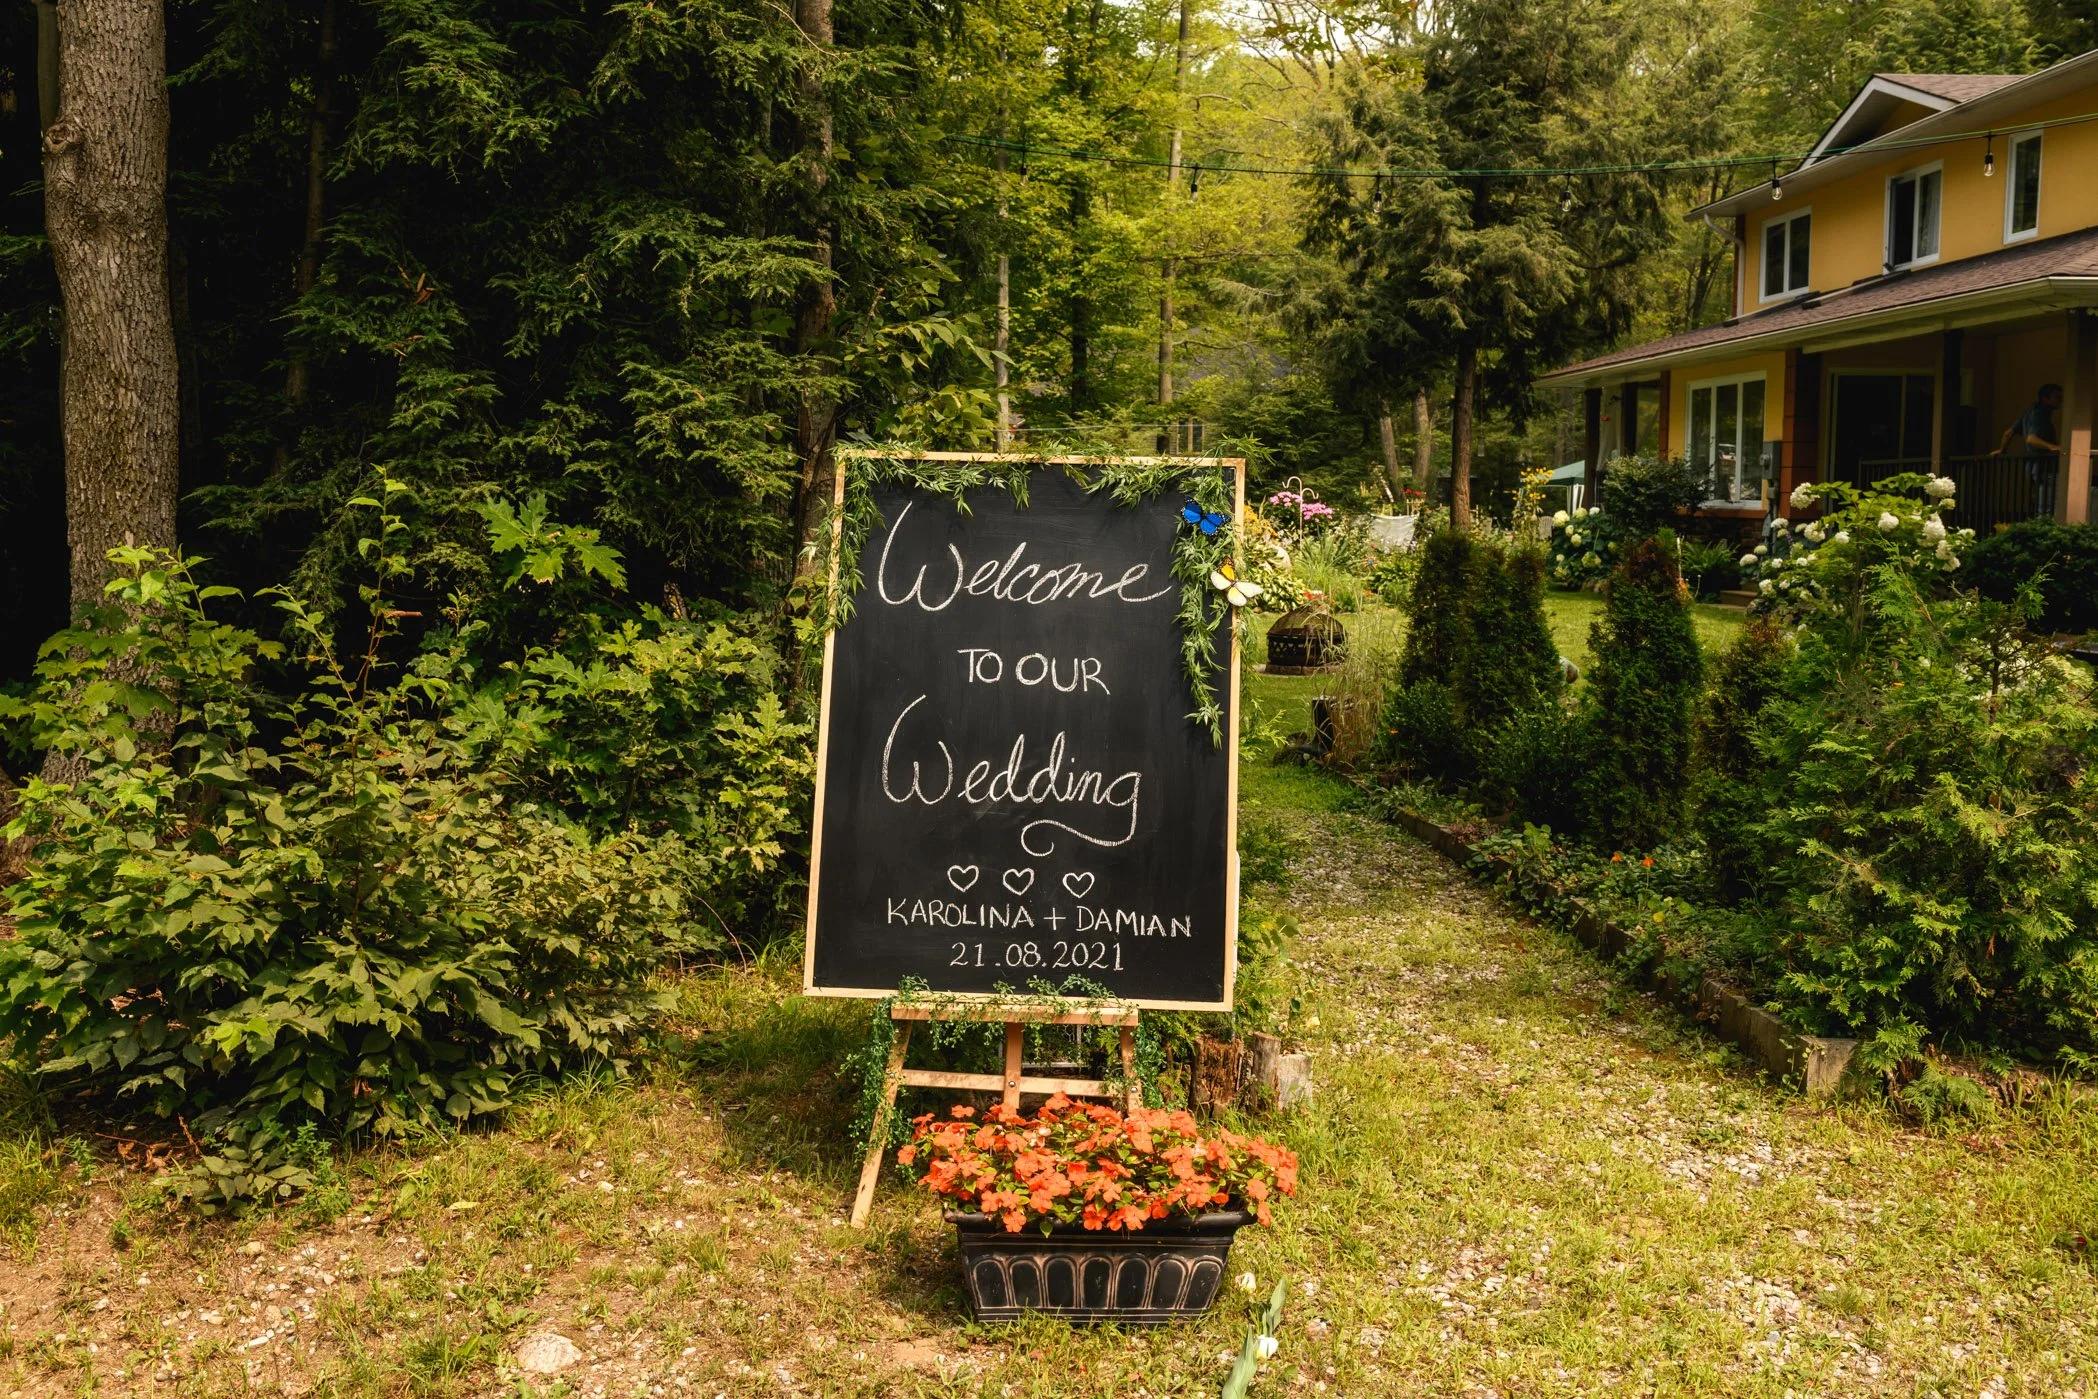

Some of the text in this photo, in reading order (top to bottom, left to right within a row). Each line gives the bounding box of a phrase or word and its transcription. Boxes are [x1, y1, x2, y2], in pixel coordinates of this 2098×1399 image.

[877, 500, 1172, 612] Welcome
[957, 648, 1111, 696] TO OUR
[881, 694, 1143, 857] Wedding
[887, 898, 1035, 930] KAROLINA
[1076, 905, 1193, 938] DAMIAN
